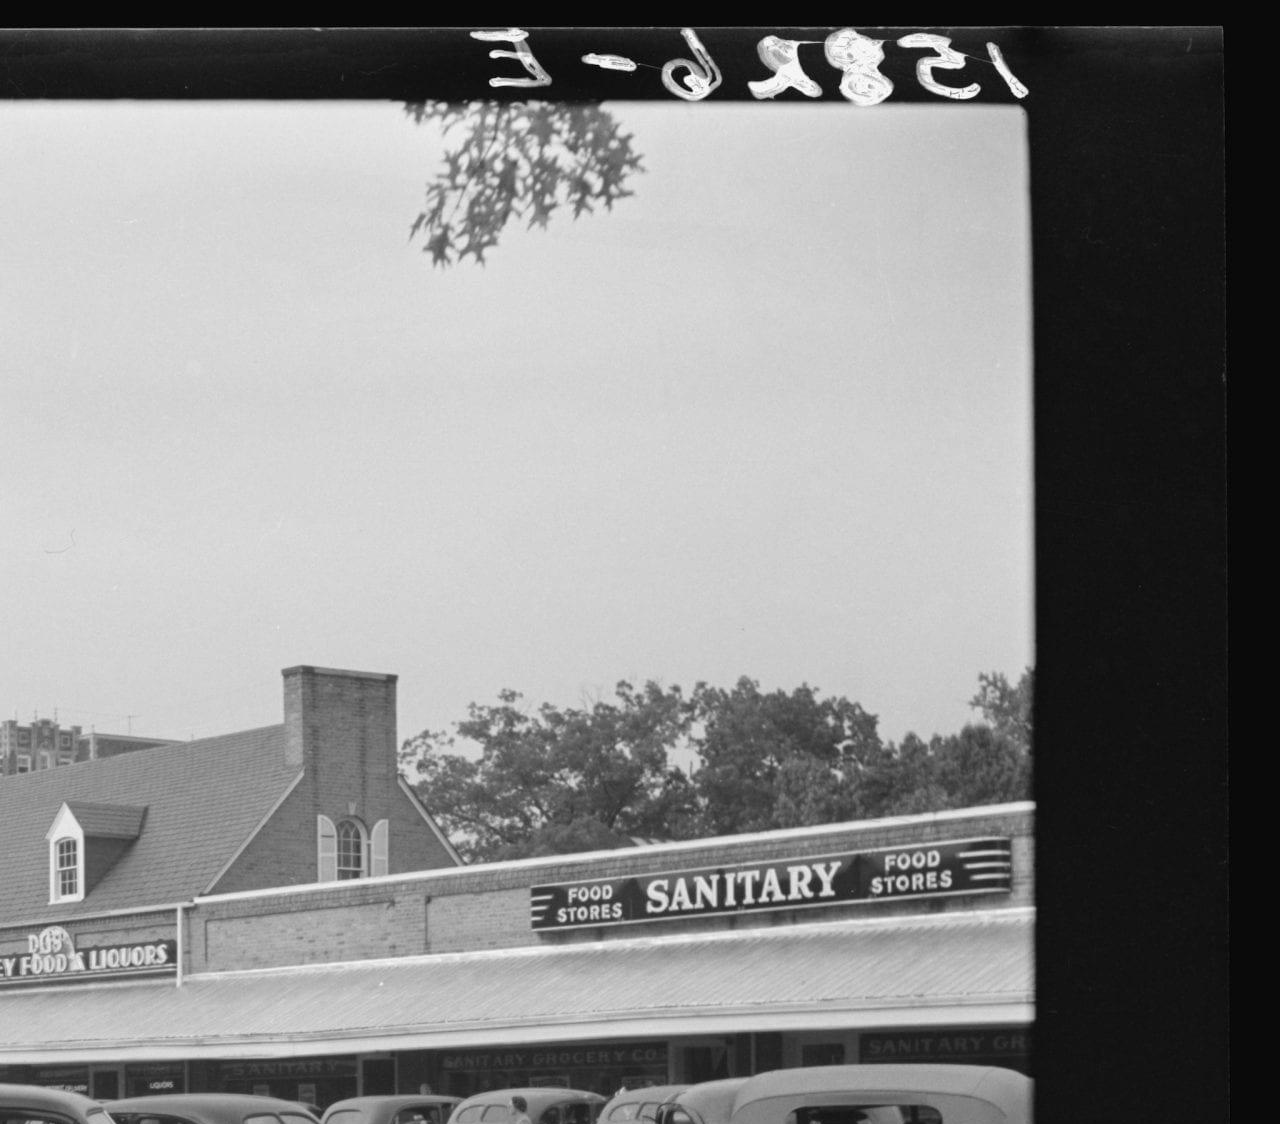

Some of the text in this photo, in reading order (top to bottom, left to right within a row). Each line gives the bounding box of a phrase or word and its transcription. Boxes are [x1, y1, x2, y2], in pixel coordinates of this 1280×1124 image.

[883, 850, 941, 872] FOOD
[645, 861, 843, 914] SANITARY
[870, 869, 953, 894] STORES
[566, 883, 613, 904] FOOD
[556, 902, 623, 923] STORES
[20, 953, 68, 976] FOOD
[88, 943, 169, 970] LIQUORS
[868, 1036, 984, 1055] SANITARY
[231, 1060, 338, 1076] SANITARY
[442, 1052, 525, 1069] SANITARY
[531, 1050, 625, 1066] GROCERY
[148, 1081, 174, 1089] LIQUORS
